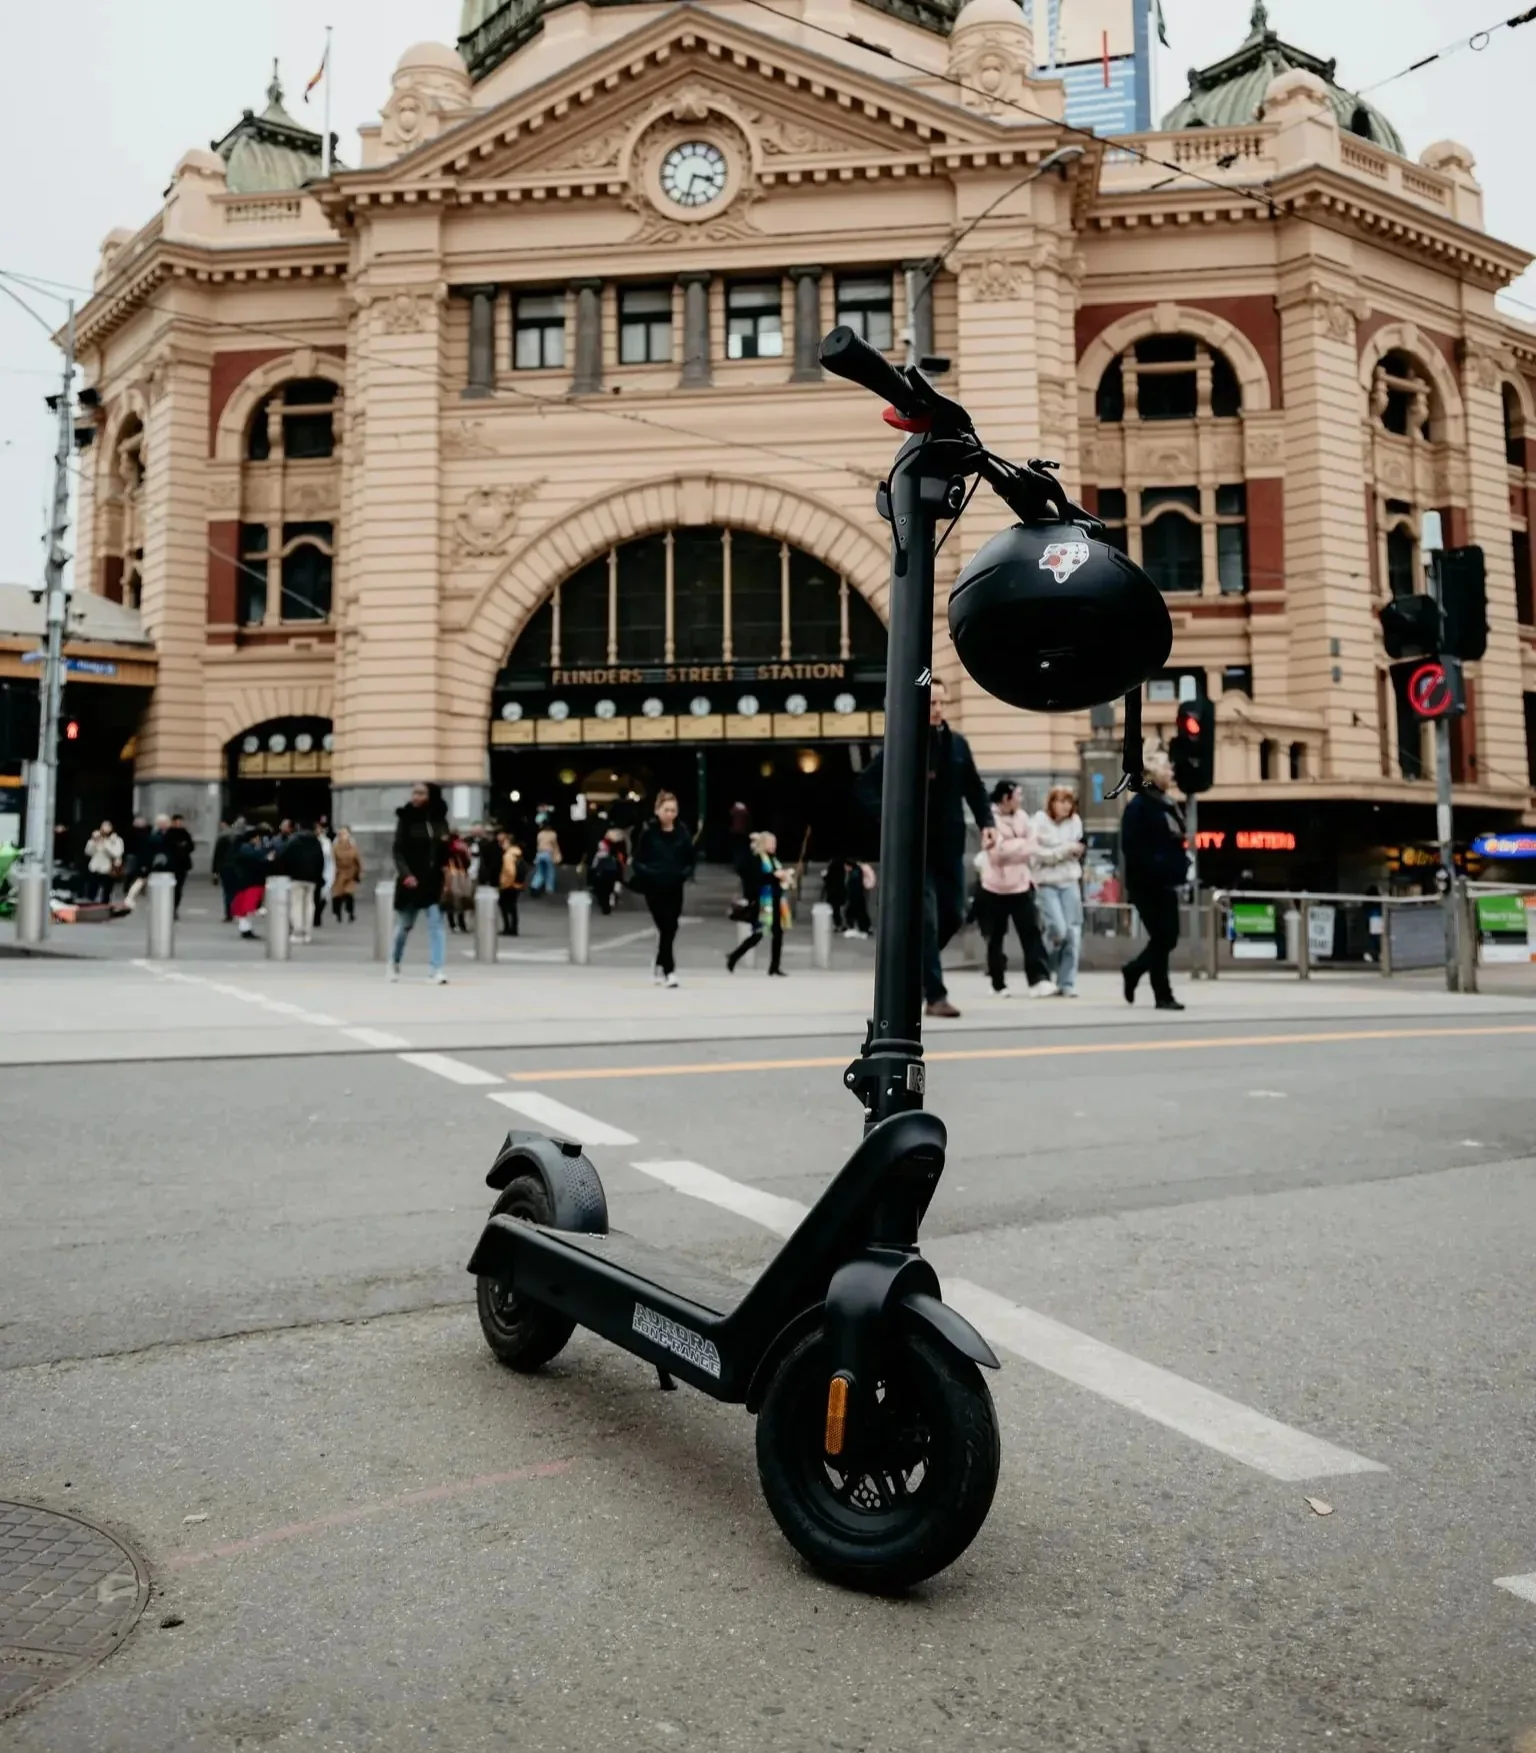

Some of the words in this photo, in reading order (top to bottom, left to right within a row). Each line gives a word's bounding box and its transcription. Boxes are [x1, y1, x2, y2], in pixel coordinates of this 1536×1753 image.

[552, 667, 643, 685] FLINDERS
[665, 667, 734, 682] STREET
[757, 663, 845, 680] STATION
[1183, 832, 1225, 849] ITY
[634, 1302, 720, 1362] AURORA
